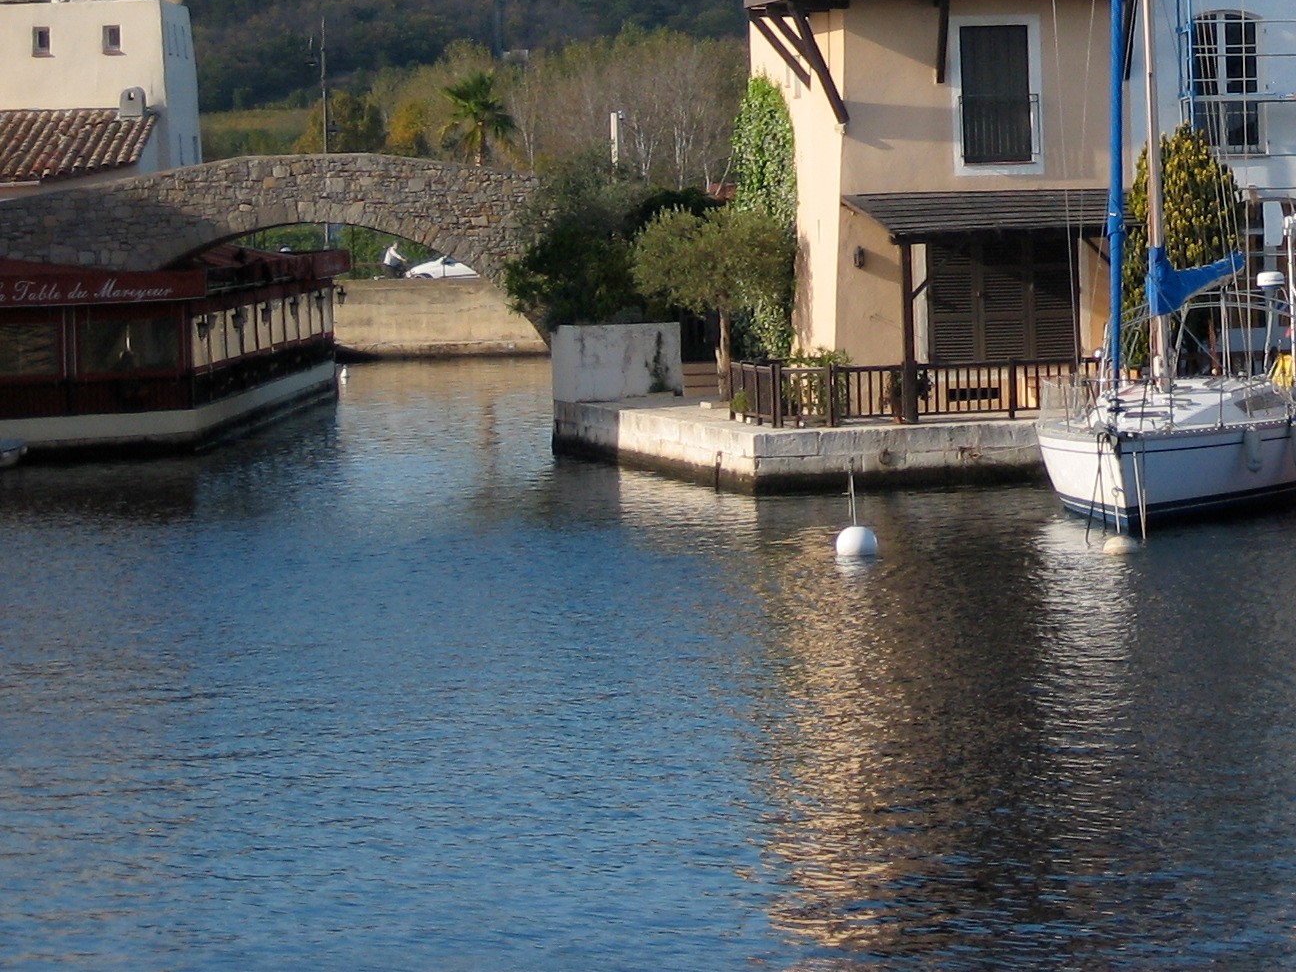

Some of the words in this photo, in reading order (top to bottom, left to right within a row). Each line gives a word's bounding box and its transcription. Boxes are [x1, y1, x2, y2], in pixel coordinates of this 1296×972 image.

[12, 280, 62, 301] Table
[67, 282, 89, 299] du
[94, 278, 173, 302] Mareyeur
